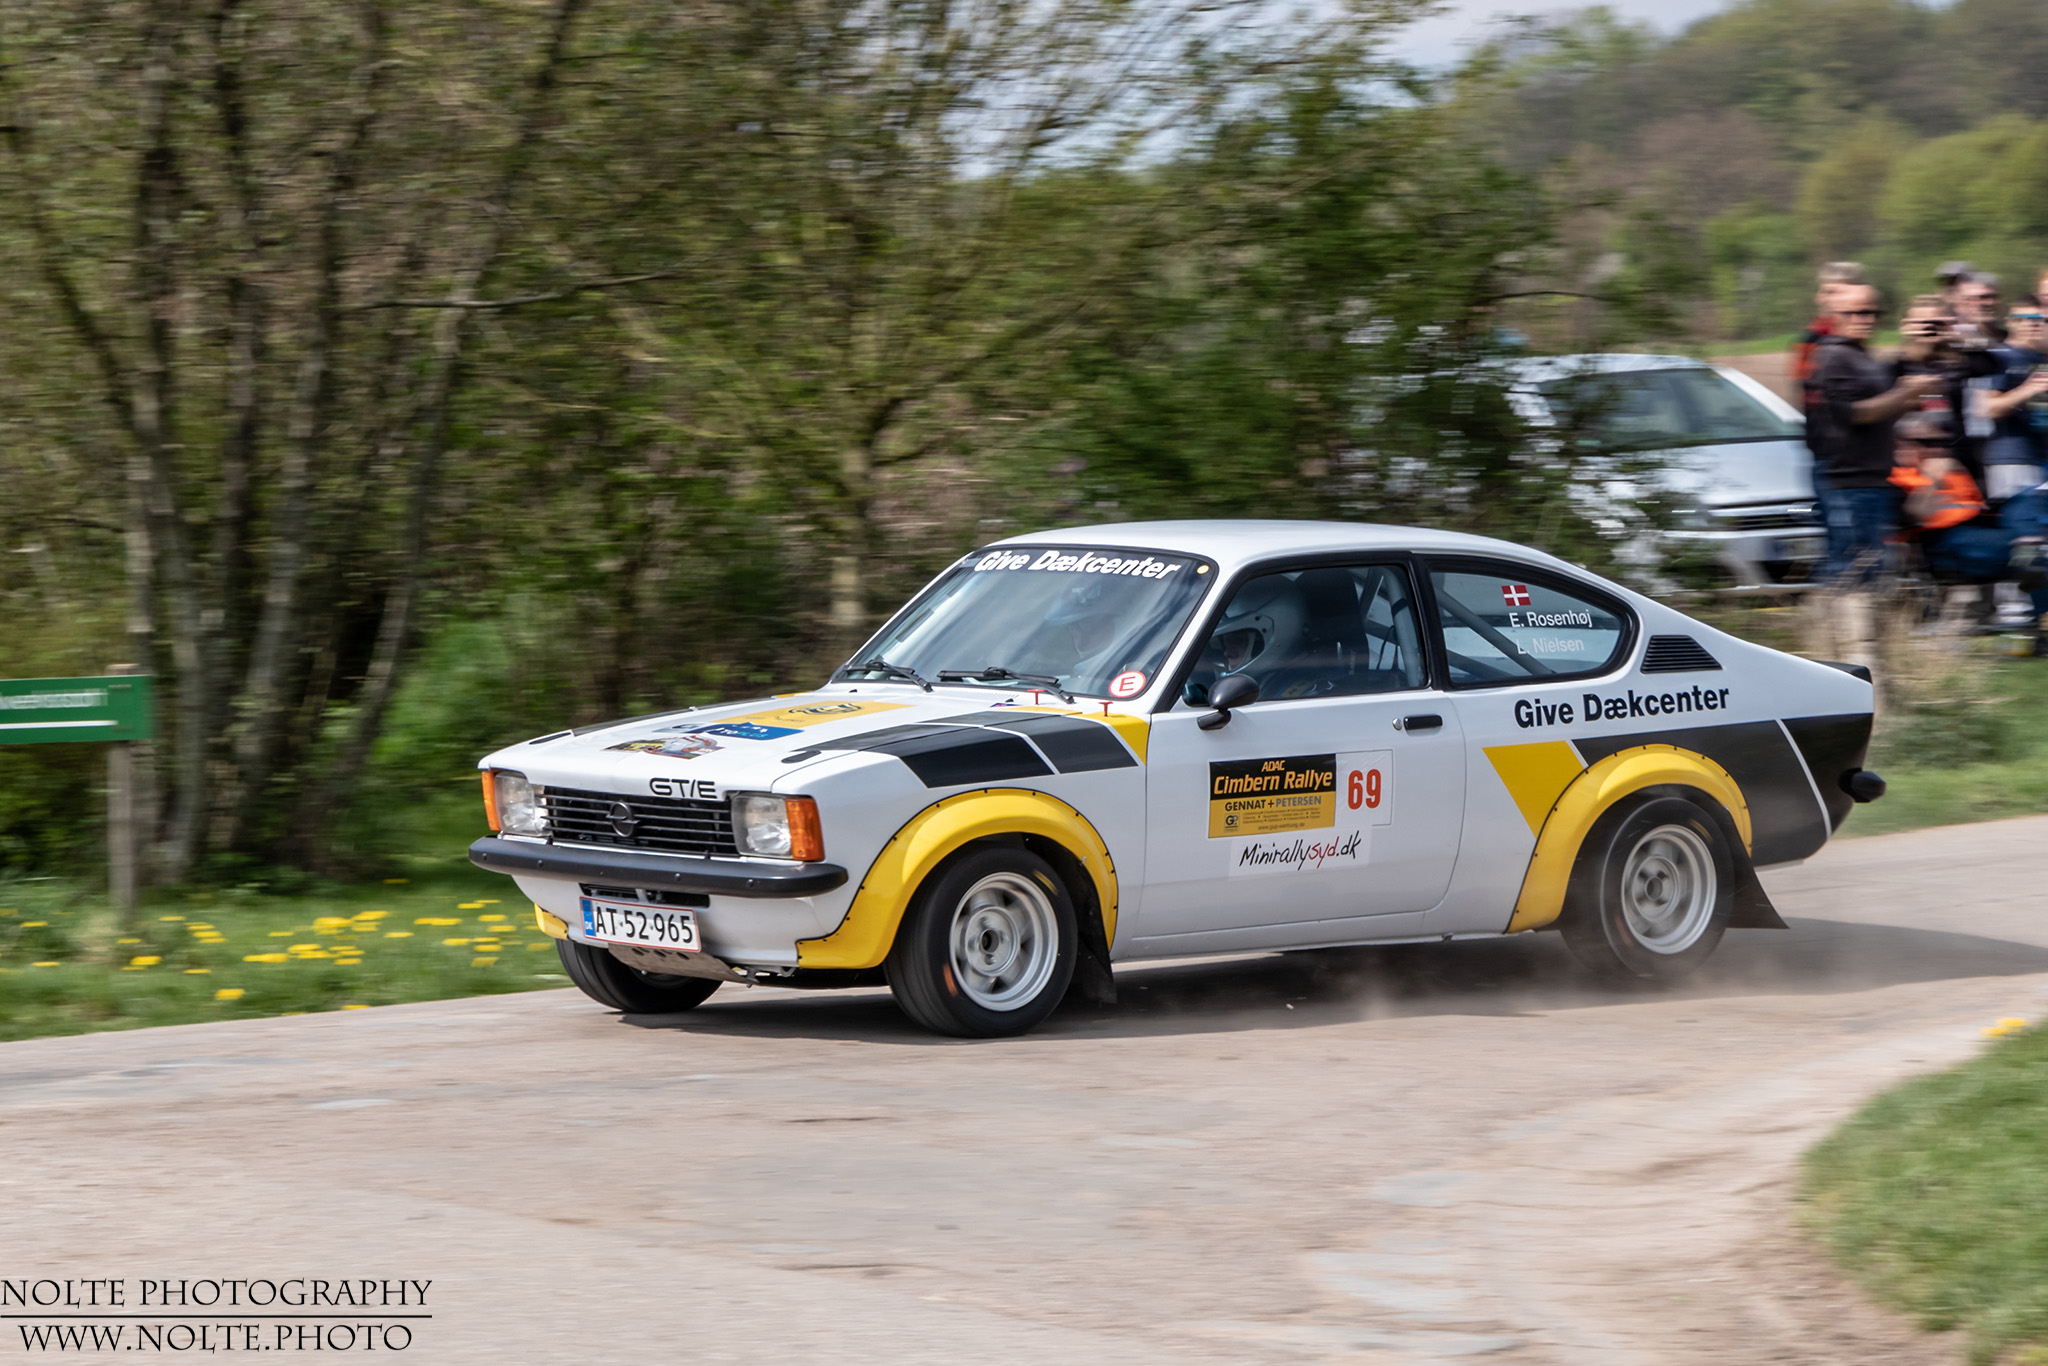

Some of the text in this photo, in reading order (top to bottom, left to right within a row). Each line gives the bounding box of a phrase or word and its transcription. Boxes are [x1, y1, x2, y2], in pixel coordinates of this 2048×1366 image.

[974, 550, 1181, 580] Give Dækcenter
[1508, 609, 1593, 628] E. Rosenhøj
[1532, 637, 1585, 654] Nielsen
[1118, 676, 1135, 692] E
[1514, 685, 1730, 729] Give Dækcenter
[1261, 760, 1286, 773] ADAC
[649, 777, 718, 800] GT/E
[1213, 769, 1333, 795] Cimbern Rallye
[1347, 769, 1382, 810] 69
[1239, 830, 1362, 871] Minirallysyd.dk
